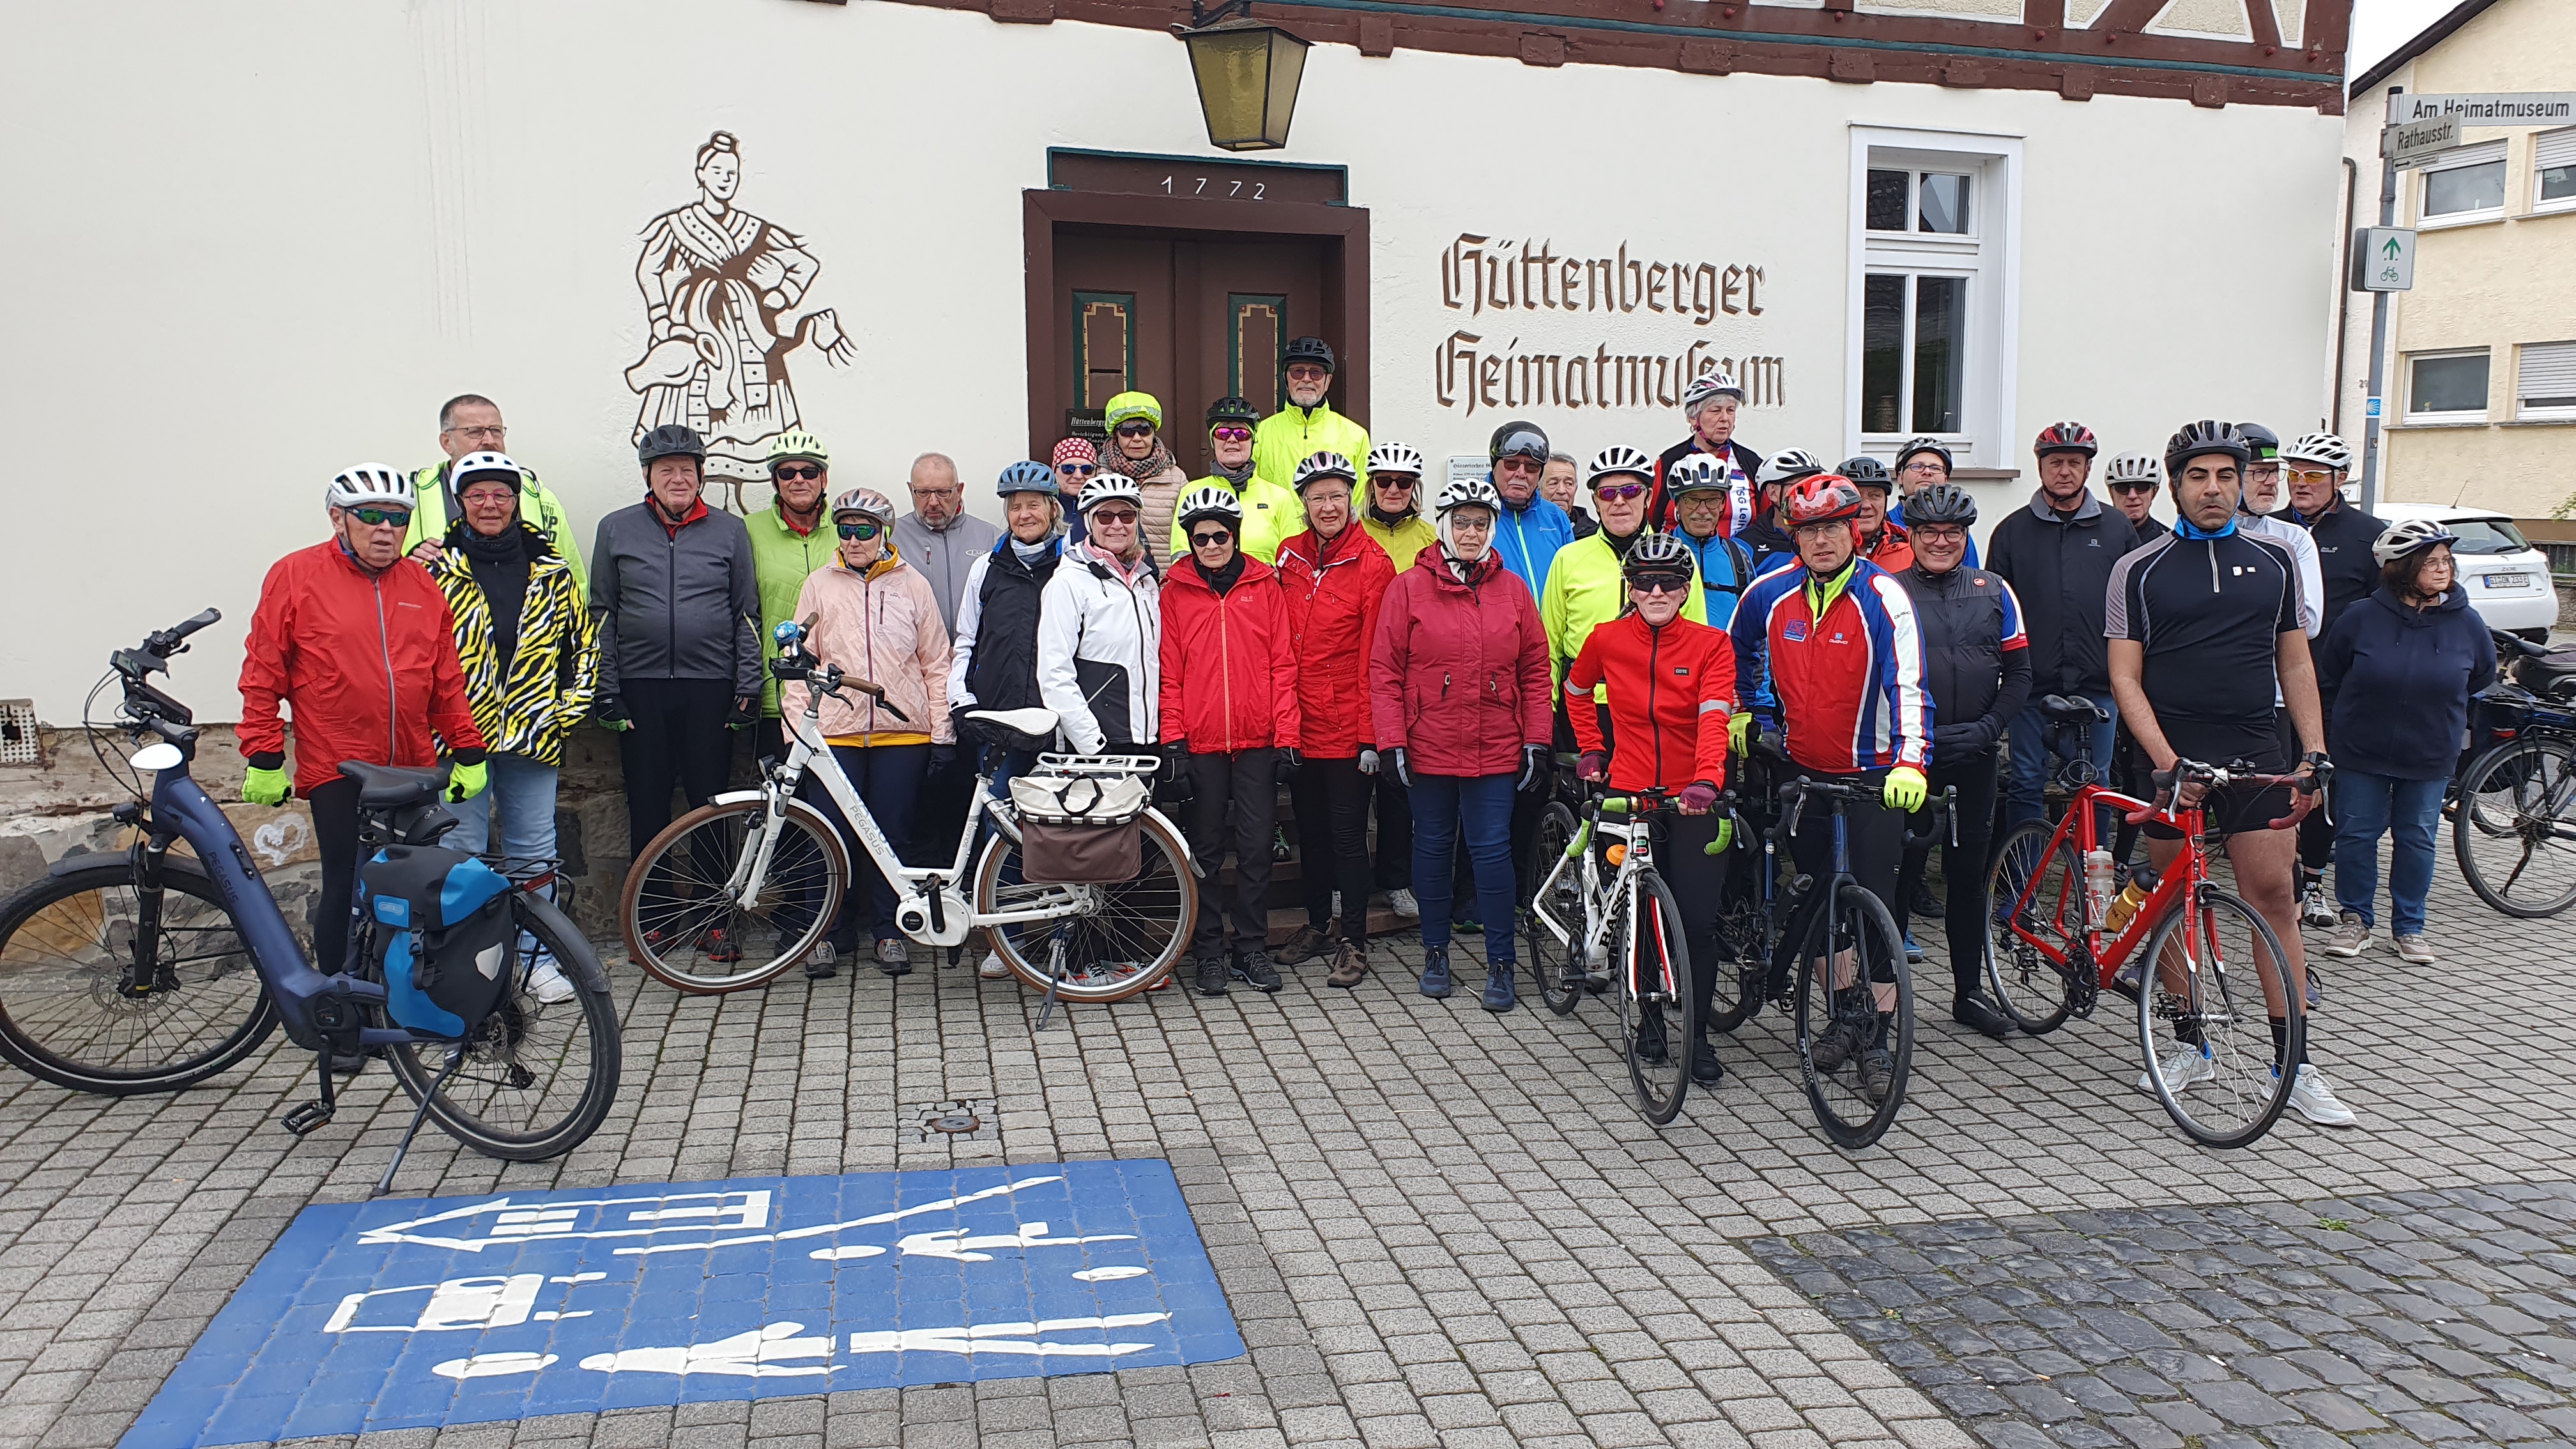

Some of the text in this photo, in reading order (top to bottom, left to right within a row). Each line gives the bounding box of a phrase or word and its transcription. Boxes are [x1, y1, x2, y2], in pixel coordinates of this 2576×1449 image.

[2412, 98, 2570, 119] Am Heimatmuseum
[2397, 122, 2454, 151] Rathausstr.
[1441, 233, 1766, 326] Hüttenberger
[1071, 417, 1105, 427] Hüttenberge
[849, 805, 885, 855] PEGASUS
[962, 823, 974, 848] SOLERO
[208, 851, 239, 904] PEGASUS
[1803, 1057, 1814, 1087] SWISS
